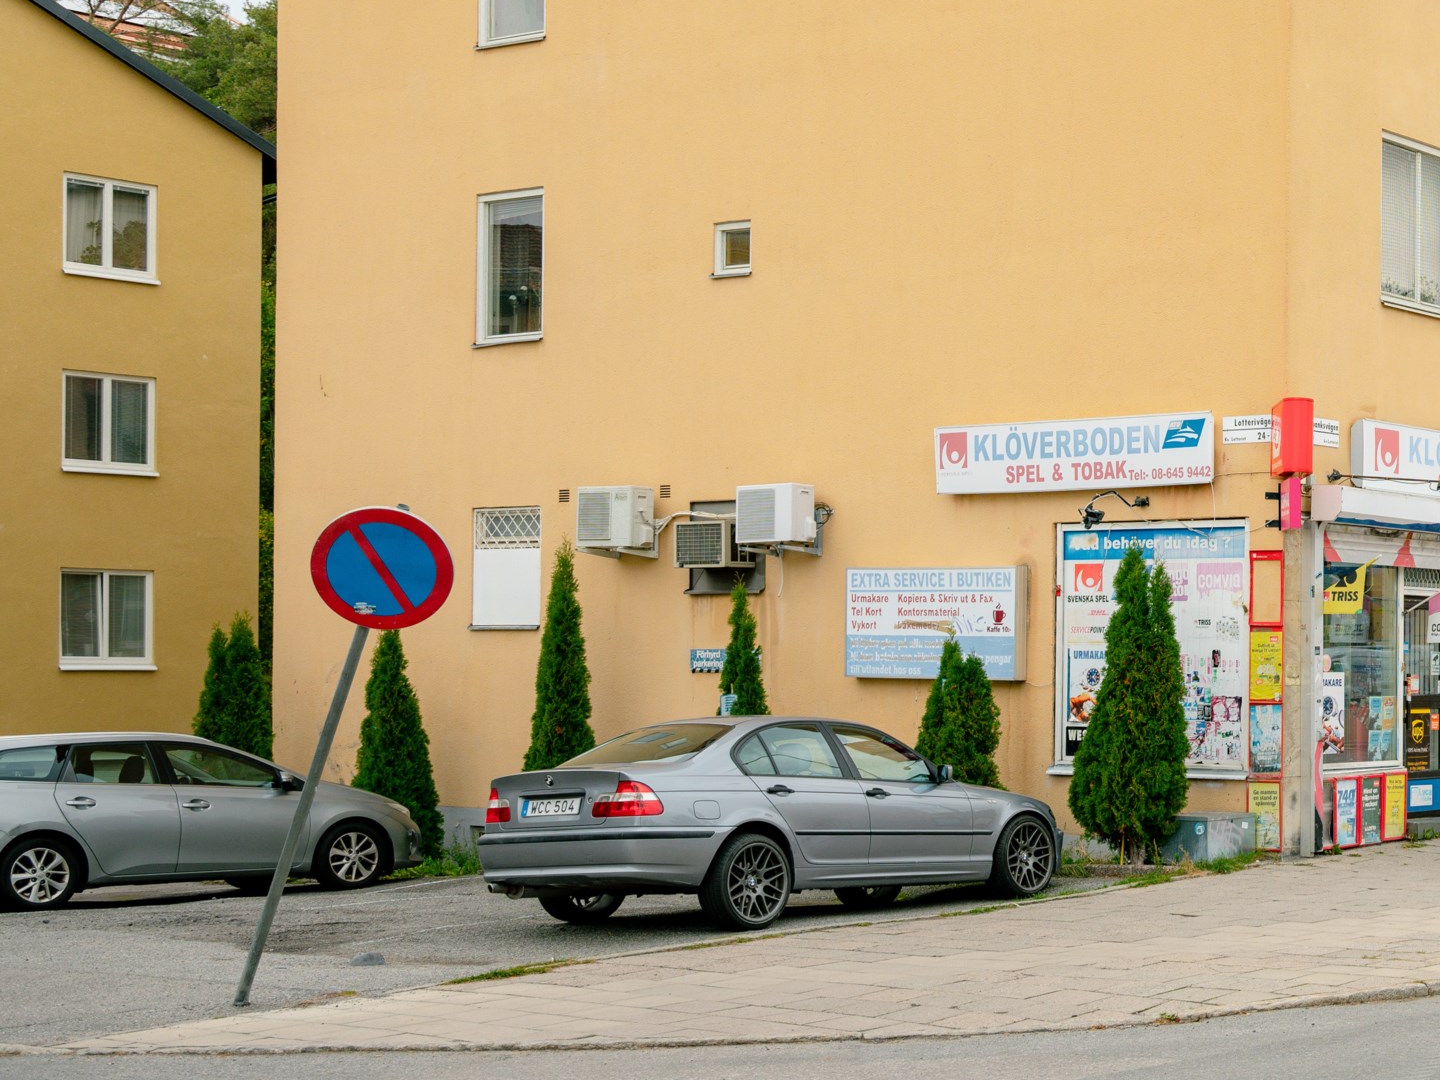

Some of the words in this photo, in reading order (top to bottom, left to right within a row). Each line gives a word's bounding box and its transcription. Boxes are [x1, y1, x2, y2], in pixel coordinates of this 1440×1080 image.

[1233, 417, 1273, 427] Lotteriväge
[1257, 432, 1266, 440] 24
[974, 423, 1160, 462] KLÖVERBODEN
[1006, 463, 1045, 484] SPEL
[1052, 463, 1063, 482] &
[1071, 460, 1127, 482] TOBAK
[1151, 466, 1184, 479] 08-645
[1186, 465, 1211, 478] 9442
[1104, 535, 1160, 550] behöver
[1164, 535, 1182, 550] du
[1186, 535, 1218, 552] idag
[1222, 537, 1231, 548] ?
[851, 572, 890, 588] EXTRA
[894, 572, 945, 588] SERVICE
[949, 572, 953, 587] I
[957, 572, 1011, 587] BUTIKEN
[1198, 573, 1241, 589] COMVIQ
[851, 594, 889, 603] Urmakare
[897, 593, 927, 605] Kopiera
[930, 594, 935, 603] &
[938, 593, 958, 603] Skriv
[960, 594, 969, 603] ut
[971, 594, 977, 603] &
[979, 594, 993, 603] Fax
[1067, 594, 1094, 603] SVENSKA
[1095, 594, 1109, 602] SPEL
[1331, 591, 1358, 601] TRISS
[851, 607, 863, 616] Tel
[865, 607, 882, 616] Kort
[897, 607, 960, 617] Kontorsmaterial
[851, 620, 877, 632] Vykort
[987, 625, 1001, 633] Kaffe
[696, 650, 720, 659] Förhyrd
[693, 660, 724, 669] parkering
[985, 655, 1012, 666] pengar
[850, 664, 860, 673] till
[861, 664, 892, 674] utlandet
[894, 664, 907, 674] hos
[908, 666, 921, 674] oss
[531, 801, 551, 814] WCC
[554, 800, 575, 813] 504
